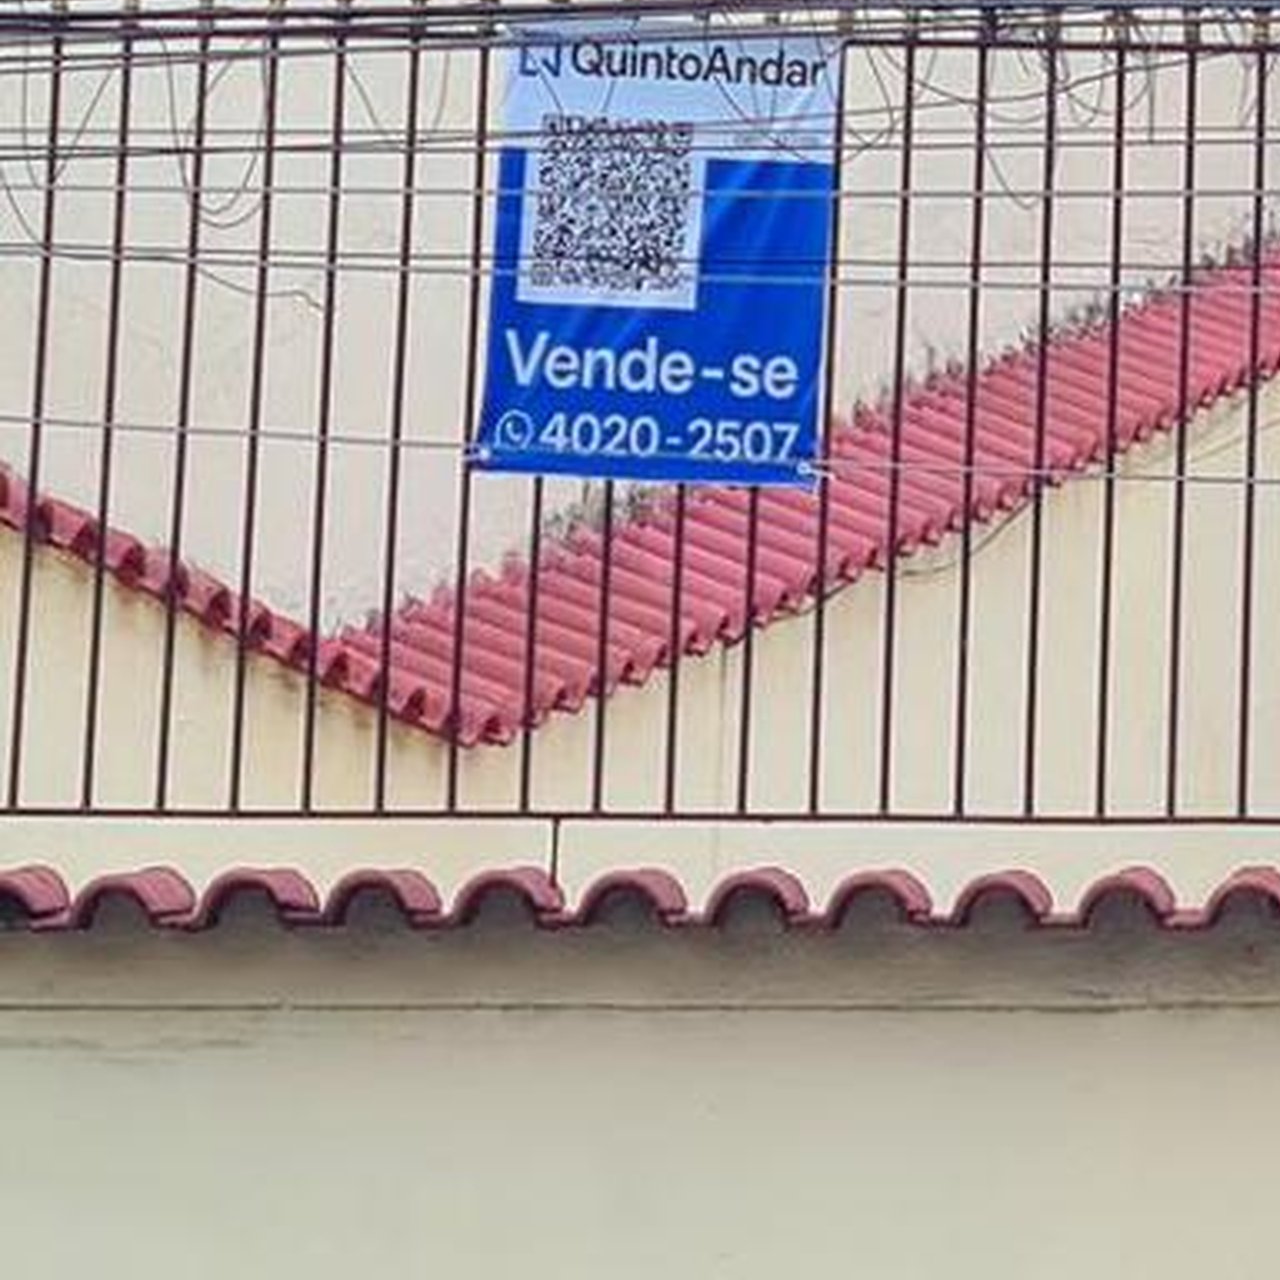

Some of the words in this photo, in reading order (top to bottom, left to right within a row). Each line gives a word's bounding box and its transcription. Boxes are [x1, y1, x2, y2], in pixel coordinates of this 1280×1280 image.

[571, 42, 827, 88] QuintoAndar
[505, 328, 799, 399] Vende-se
[539, 412, 800, 462] 4020-2507
